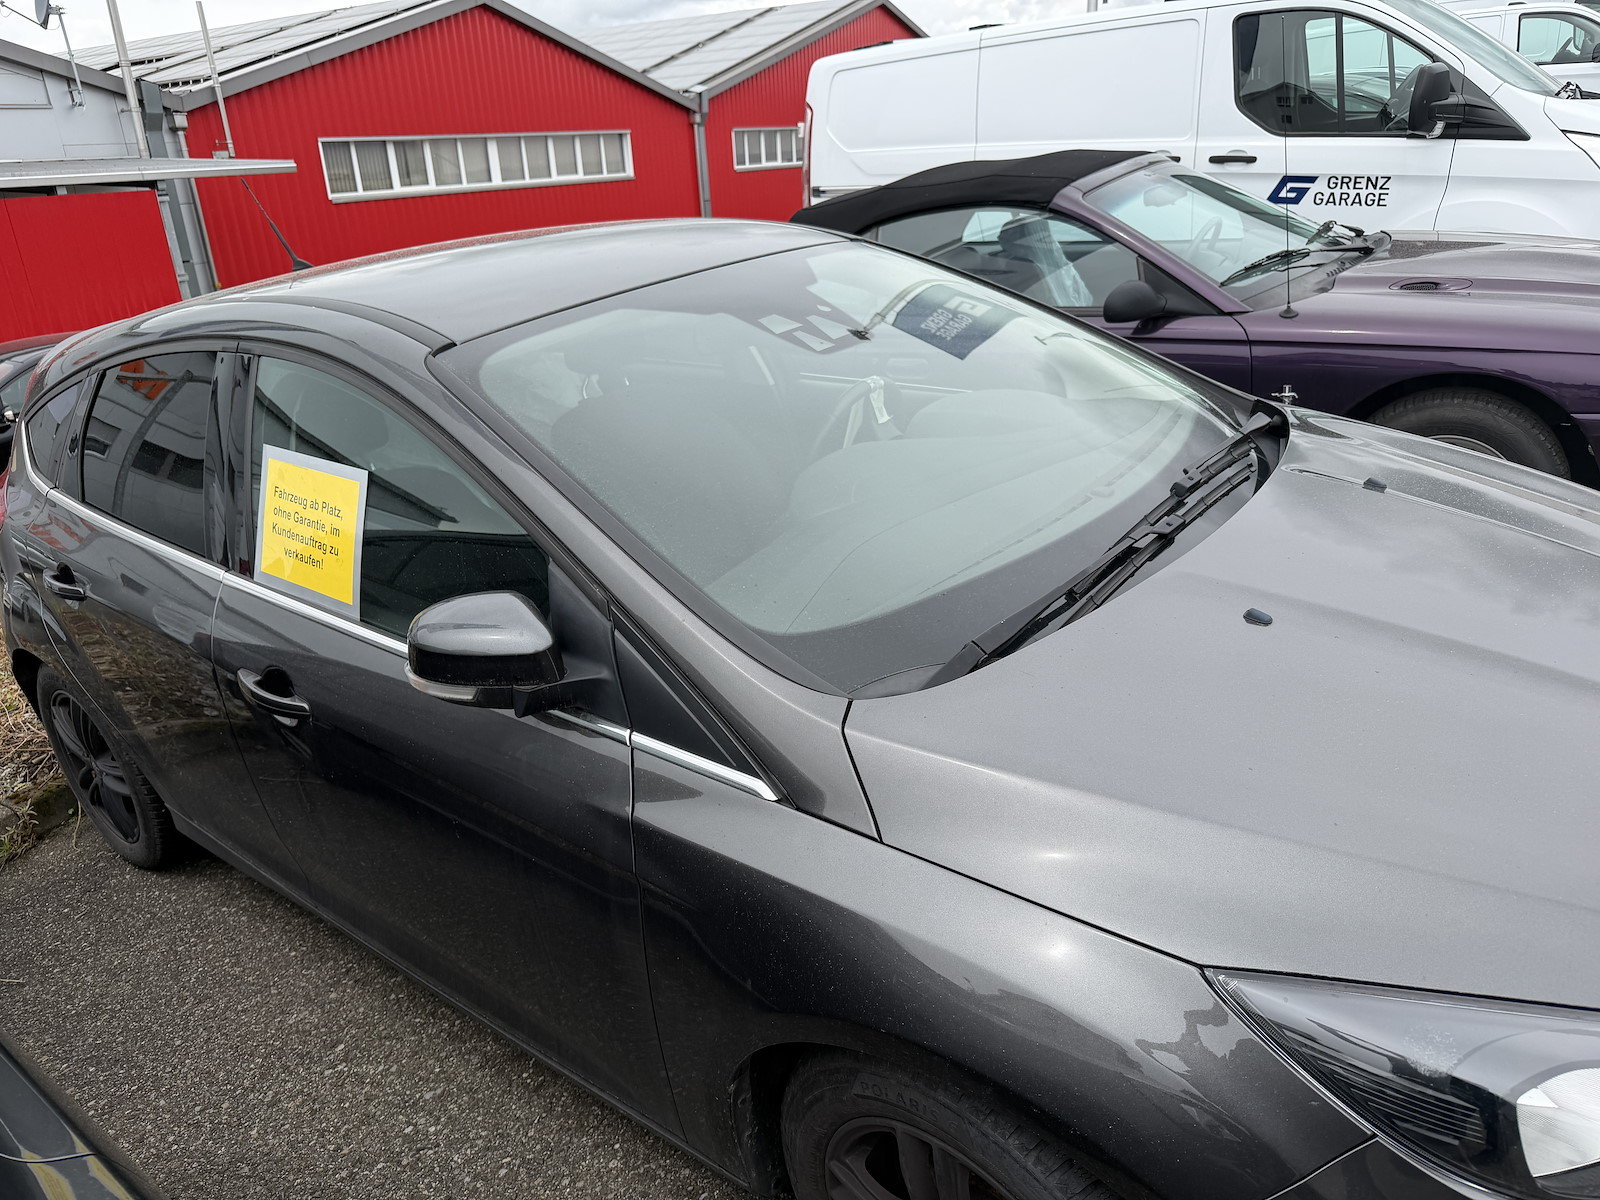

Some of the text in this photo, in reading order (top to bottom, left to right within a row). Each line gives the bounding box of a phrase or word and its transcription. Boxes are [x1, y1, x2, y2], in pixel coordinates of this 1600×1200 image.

[1327, 175, 1392, 191] GRENZ
[1313, 191, 1389, 207] GARAGE
[273, 485, 343, 521] Fahrzeug ab Platz,
[273, 505, 340, 538] ohne Garantie, im
[272, 522, 339, 557] Kundenauftrag zu
[283, 547, 324, 570] verkaufen!
